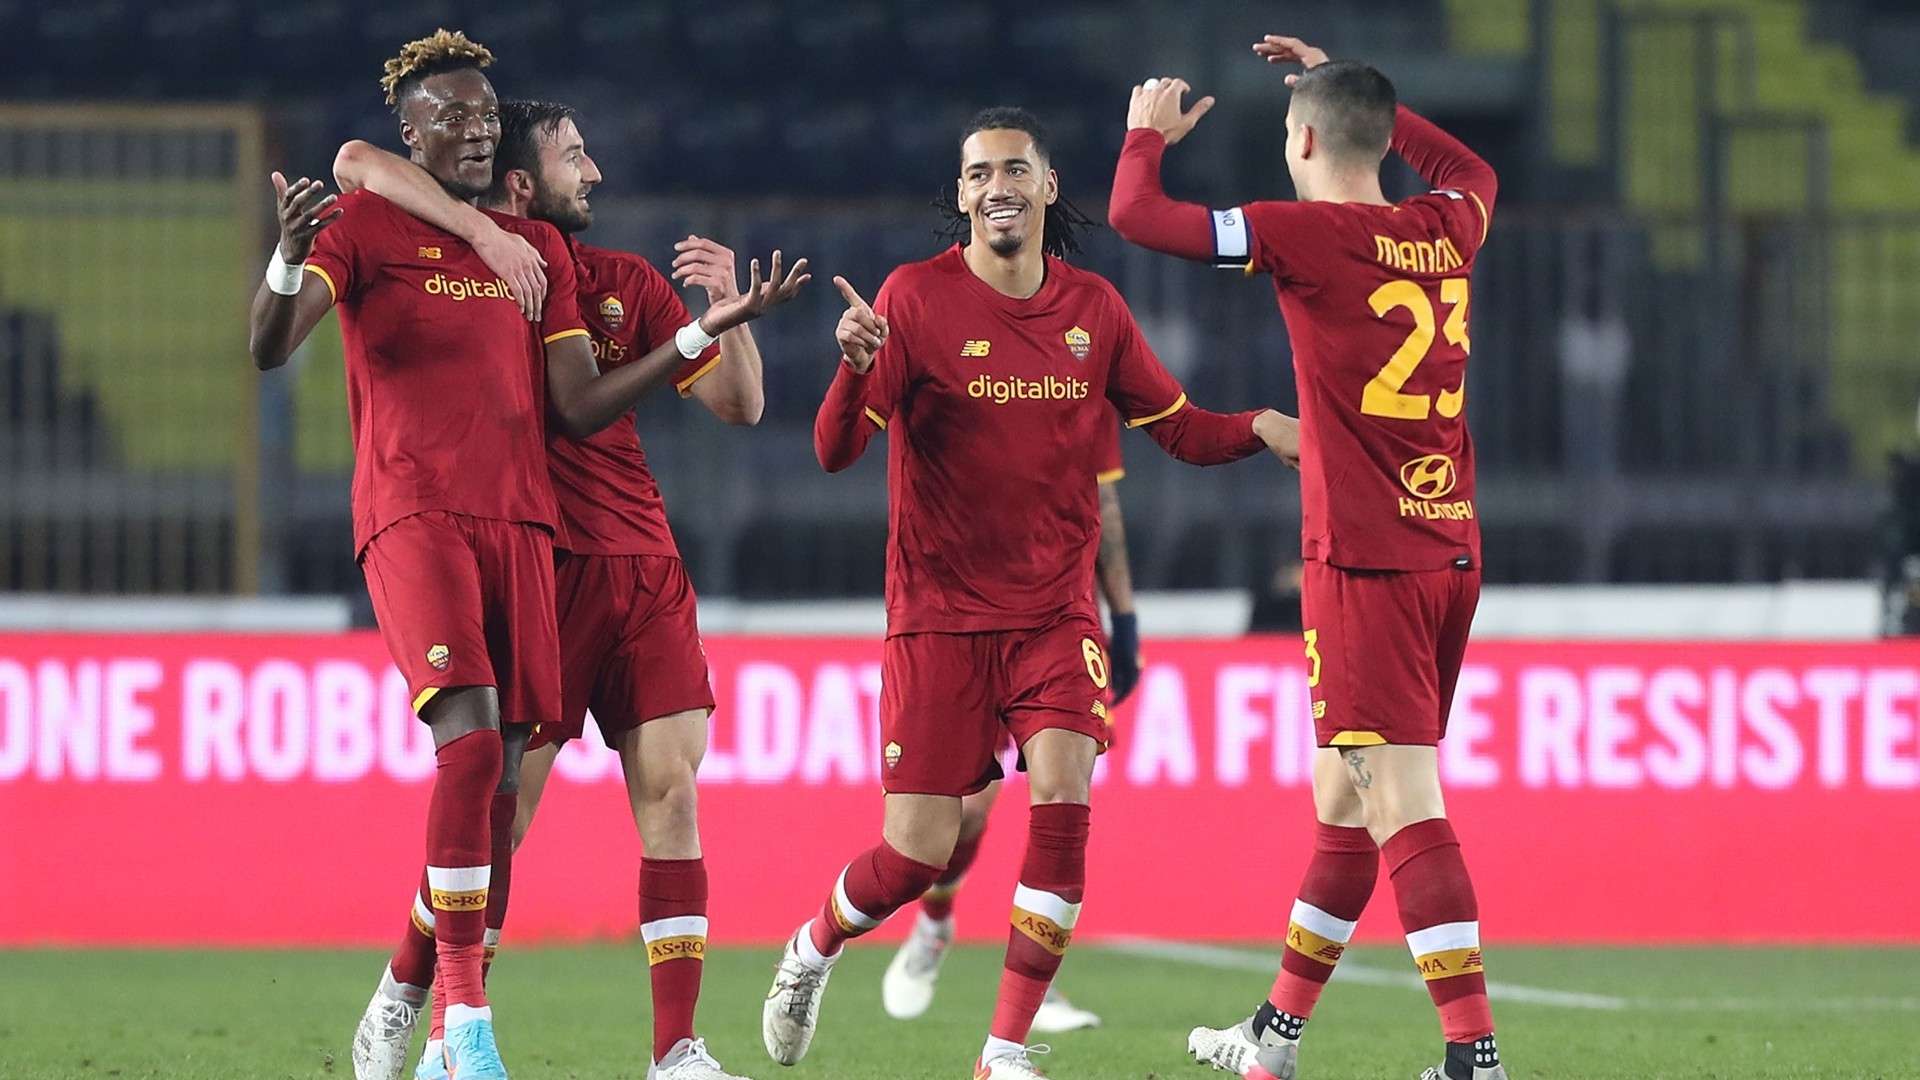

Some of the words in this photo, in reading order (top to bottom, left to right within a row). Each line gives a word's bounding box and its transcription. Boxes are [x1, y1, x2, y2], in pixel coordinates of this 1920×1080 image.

[967, 374, 1089, 404] digitalbits
[1360, 278, 1470, 420] 23
[1081, 638, 1107, 689] 6
[1520, 666, 1920, 790] RESISTE
